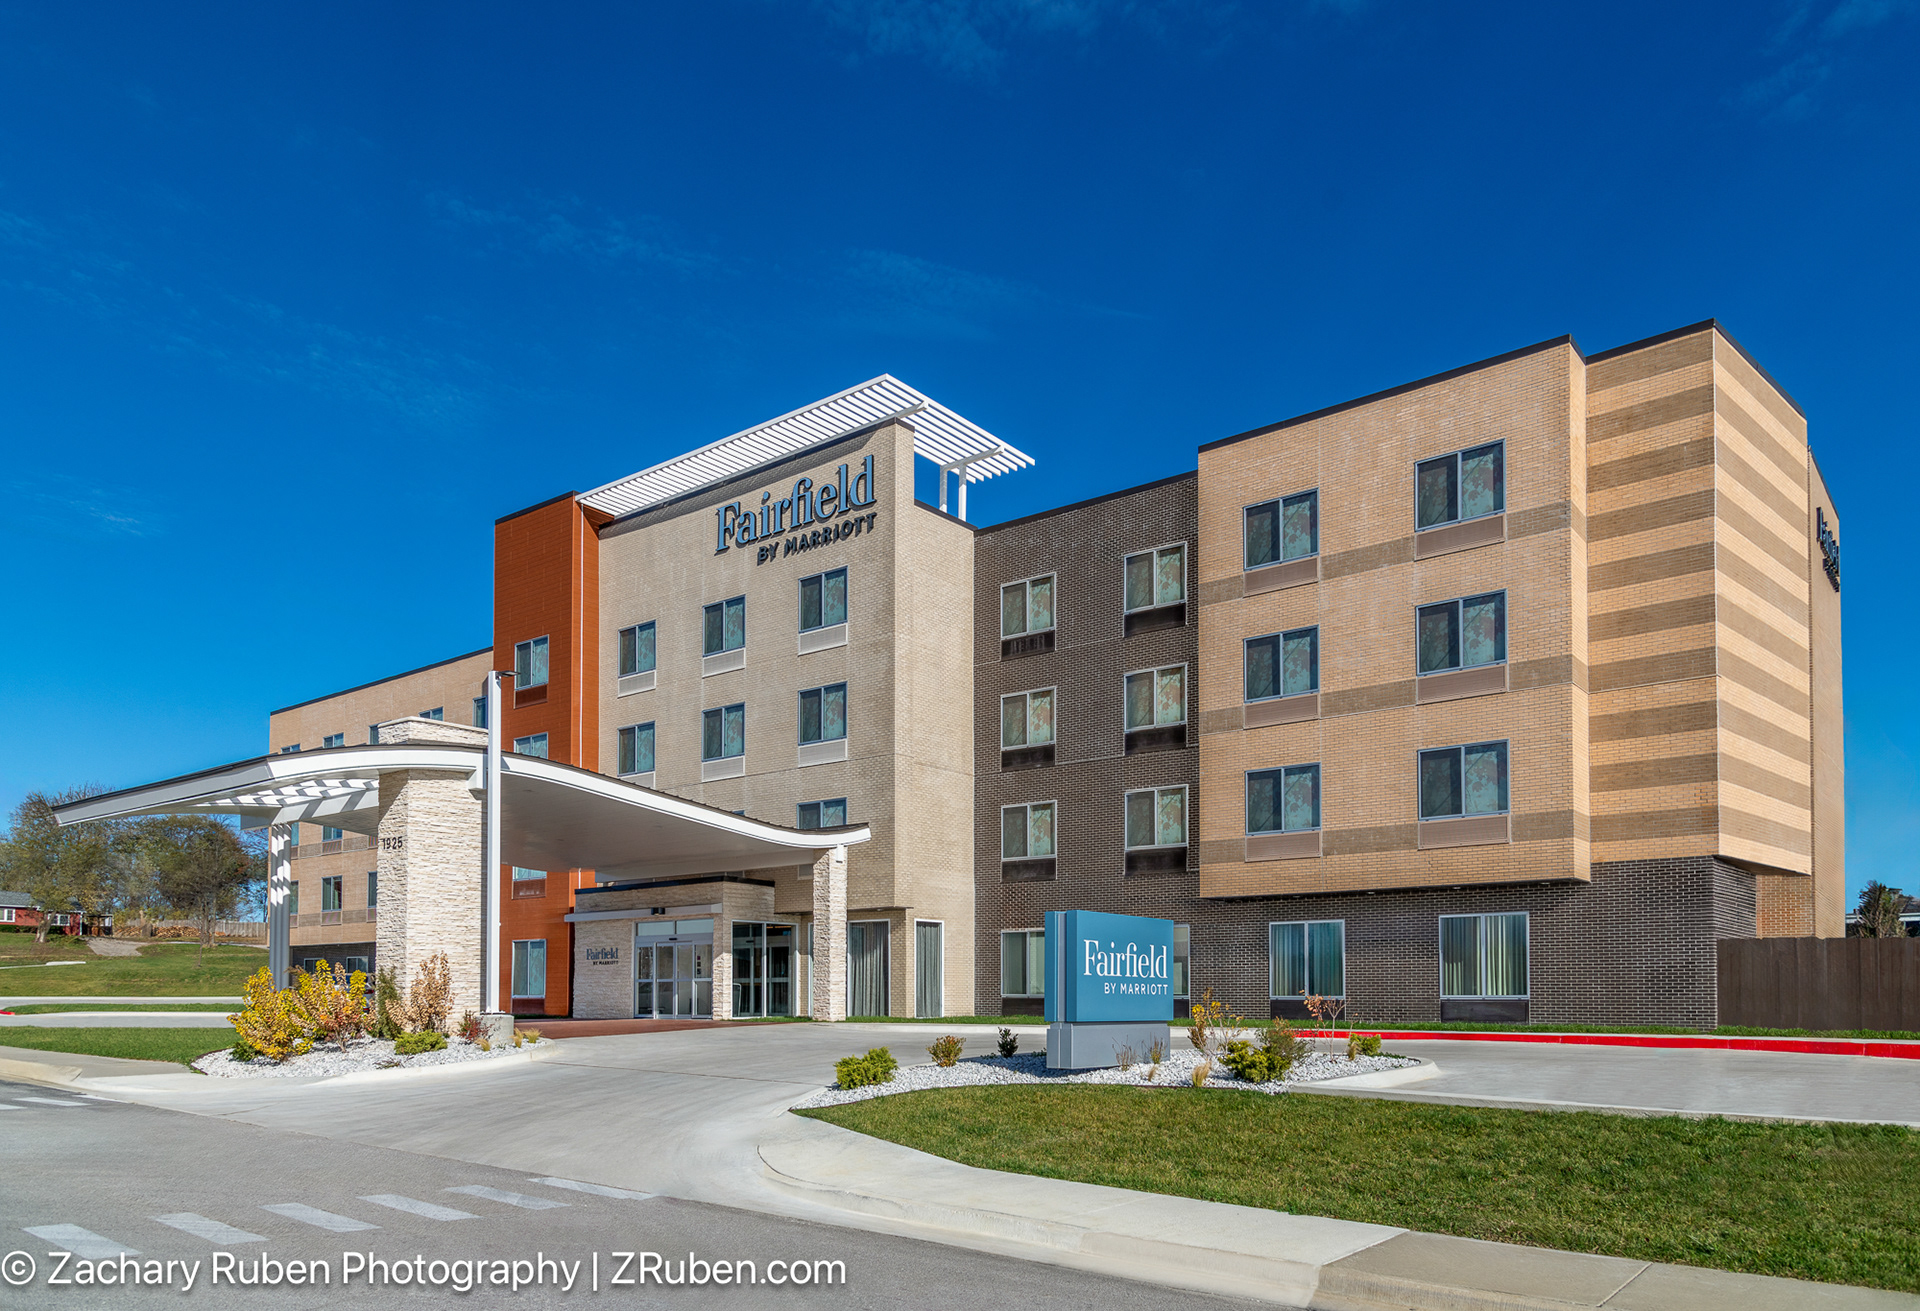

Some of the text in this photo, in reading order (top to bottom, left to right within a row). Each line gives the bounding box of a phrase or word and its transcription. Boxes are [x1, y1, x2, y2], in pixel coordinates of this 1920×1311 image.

[715, 454, 877, 551] Fairfield
[758, 512, 877, 563] BY MARRIOTT
[382, 836, 403, 850] 1925
[586, 947, 619, 960] Fairfield
[1083, 939, 1168, 979] Fairfield
[1104, 982, 1168, 995] BY MARRIOTT
